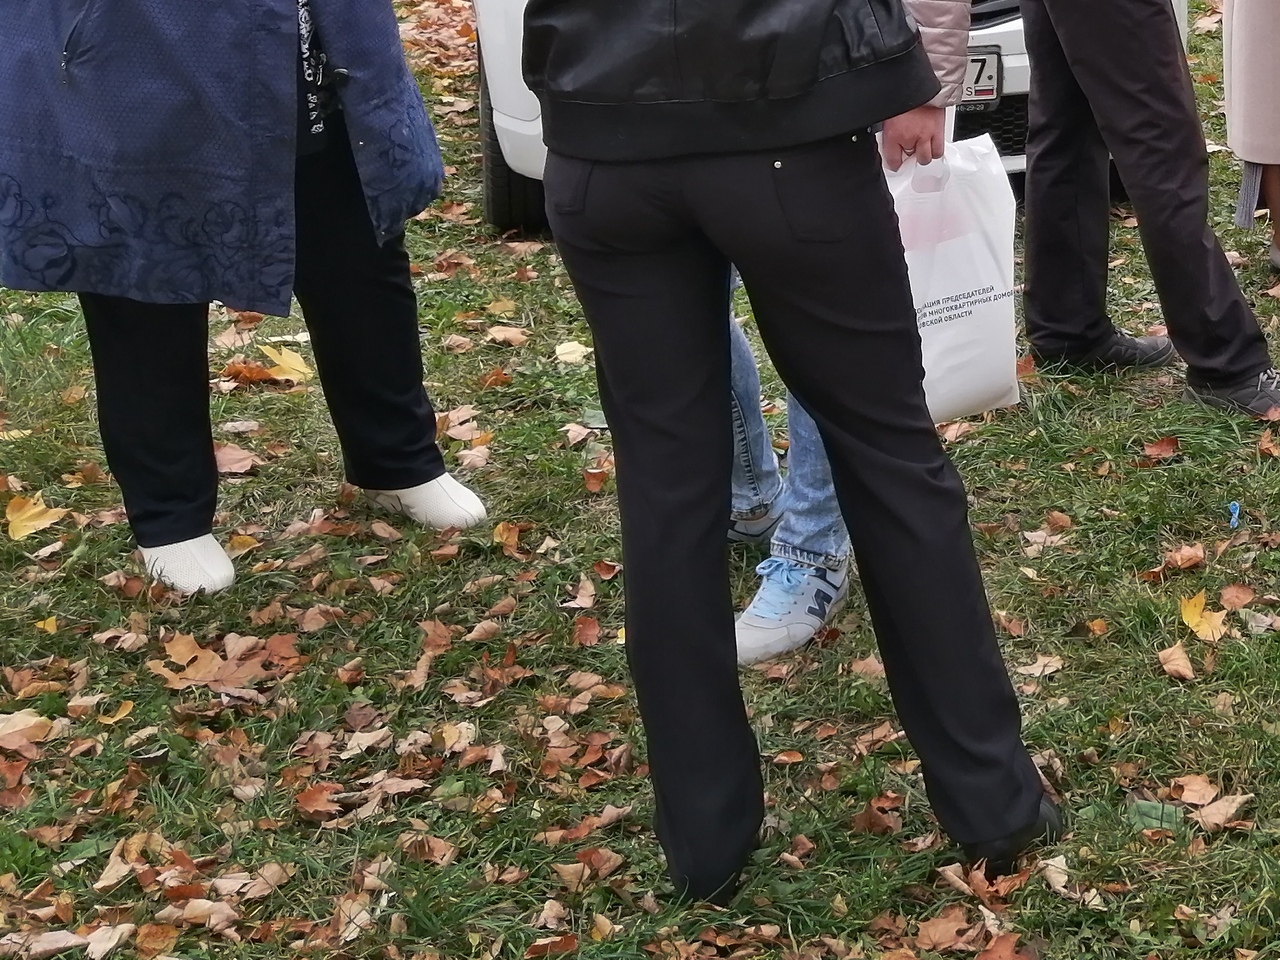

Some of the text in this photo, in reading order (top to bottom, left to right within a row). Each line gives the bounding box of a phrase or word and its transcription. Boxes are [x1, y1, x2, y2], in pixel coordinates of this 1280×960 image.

[971, 58, 987, 85] 7
[942, 285, 995, 304] ПРЕДСЕДАТЕЛЕЙ
[928, 296, 992, 317] МНОГОКВАРТИРНЫХ
[943, 310, 973, 322] ОБЛАСТИ
